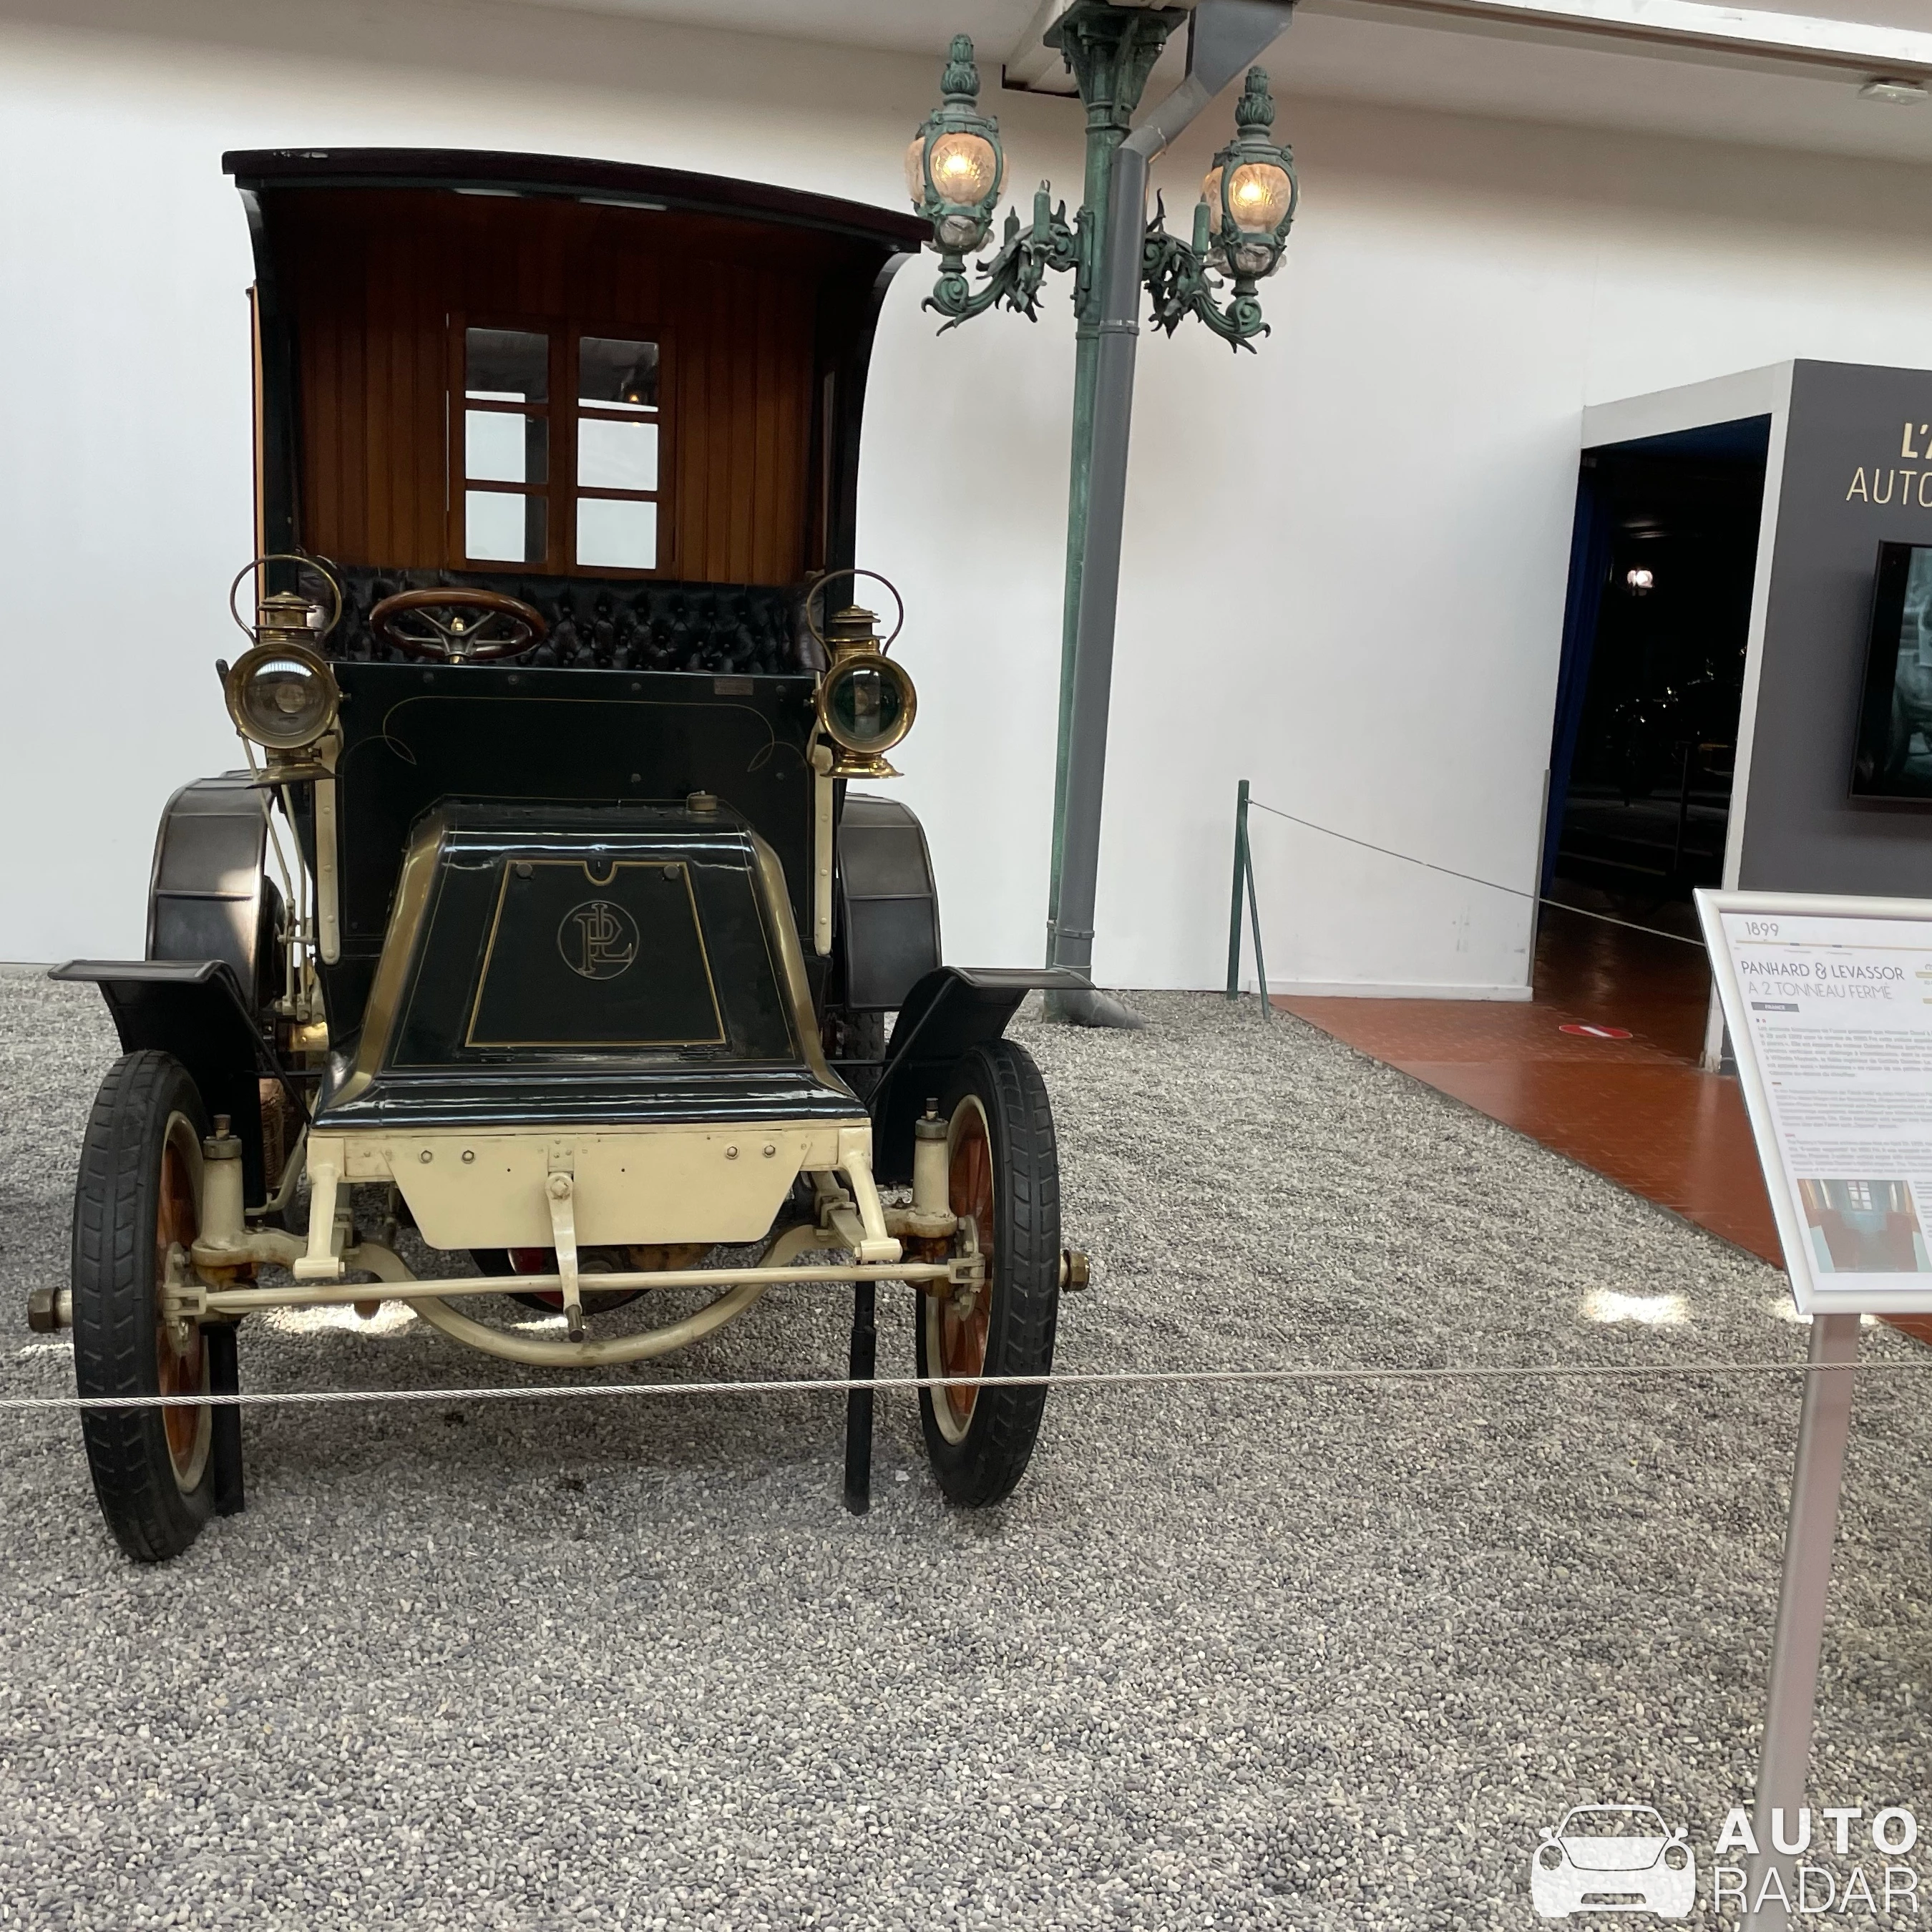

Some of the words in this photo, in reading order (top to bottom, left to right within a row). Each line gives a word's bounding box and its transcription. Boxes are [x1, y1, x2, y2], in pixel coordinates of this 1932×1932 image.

[1901, 422, 1932, 459] L'
[1745, 922, 1779, 936] 1899
[1740, 960, 1810, 977] PANHARD
[1815, 962, 1827, 980] &
[1831, 965, 1905, 980] LEVASSOR
[1748, 981, 1759, 995] A
[1762, 981, 1772, 995] 2
[1775, 982, 1845, 998] TONNEAU
